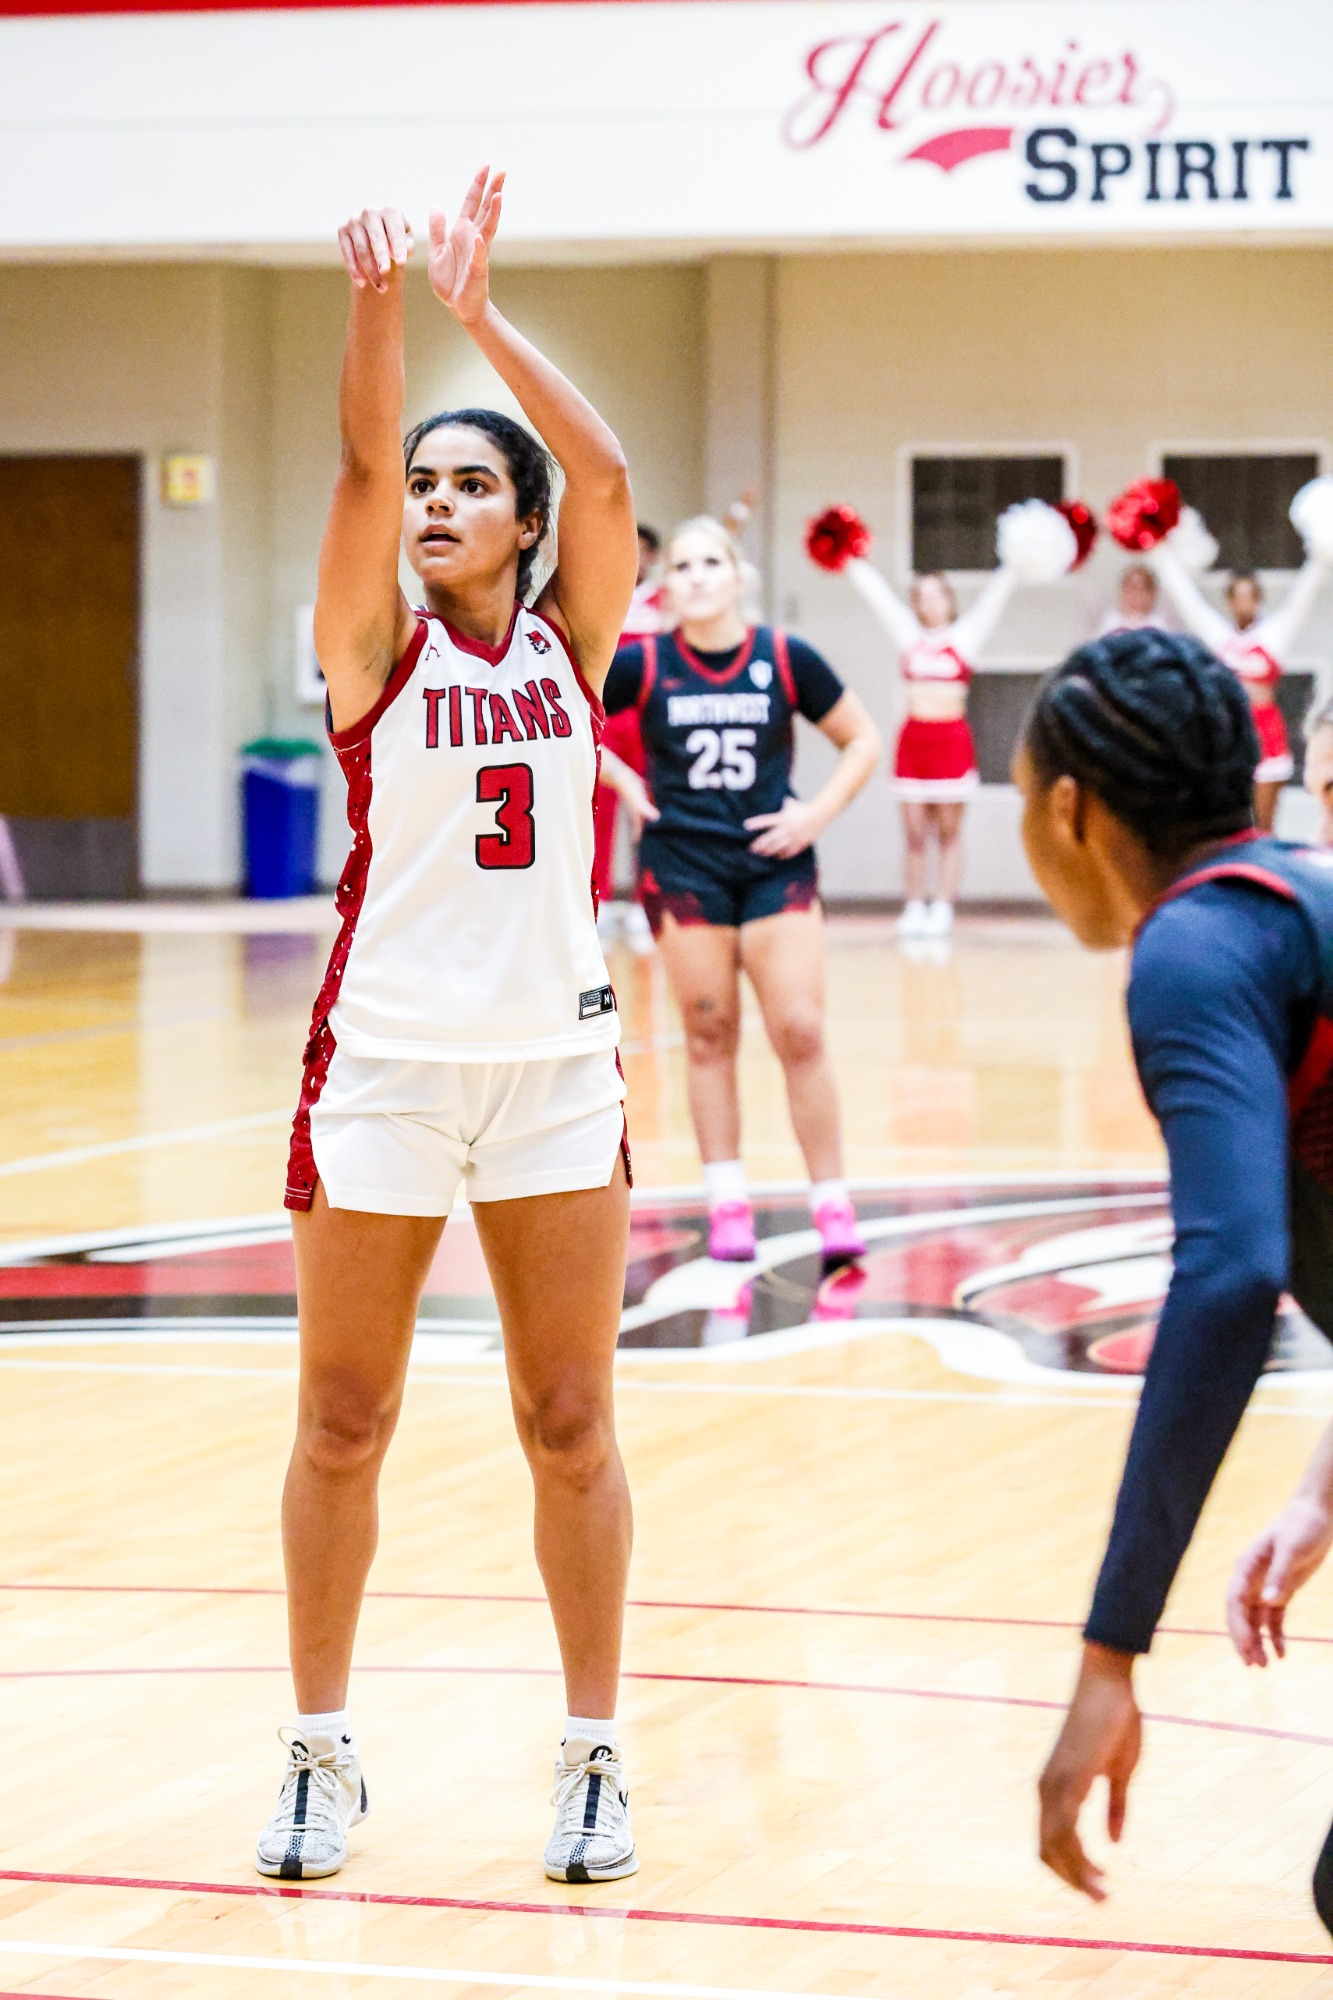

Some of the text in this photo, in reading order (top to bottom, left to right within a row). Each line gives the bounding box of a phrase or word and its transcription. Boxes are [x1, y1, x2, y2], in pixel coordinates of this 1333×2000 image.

[783, 19, 1176, 150] Hoosier
[1025, 127, 1309, 202] SPIRIT
[423, 678, 572, 749] TITANS
[686, 729, 757, 790] 25
[475, 762, 535, 870] 3
